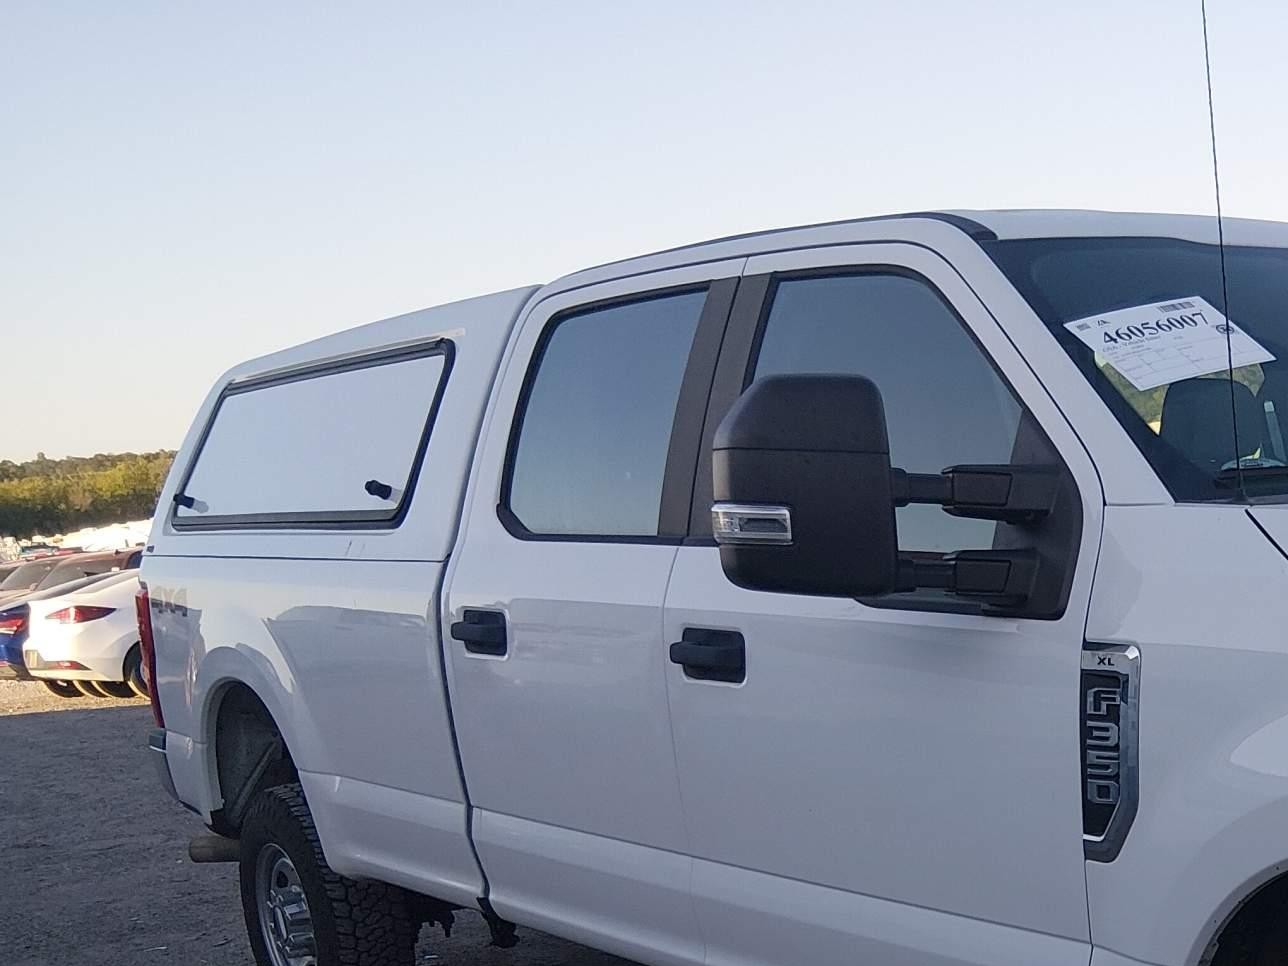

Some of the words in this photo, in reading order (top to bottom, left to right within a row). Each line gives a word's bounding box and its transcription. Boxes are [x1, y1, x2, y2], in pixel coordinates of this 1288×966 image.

[1102, 312, 1209, 345] 46056007
[1097, 656, 1115, 666] XL
[1087, 687, 1121, 804] F350
